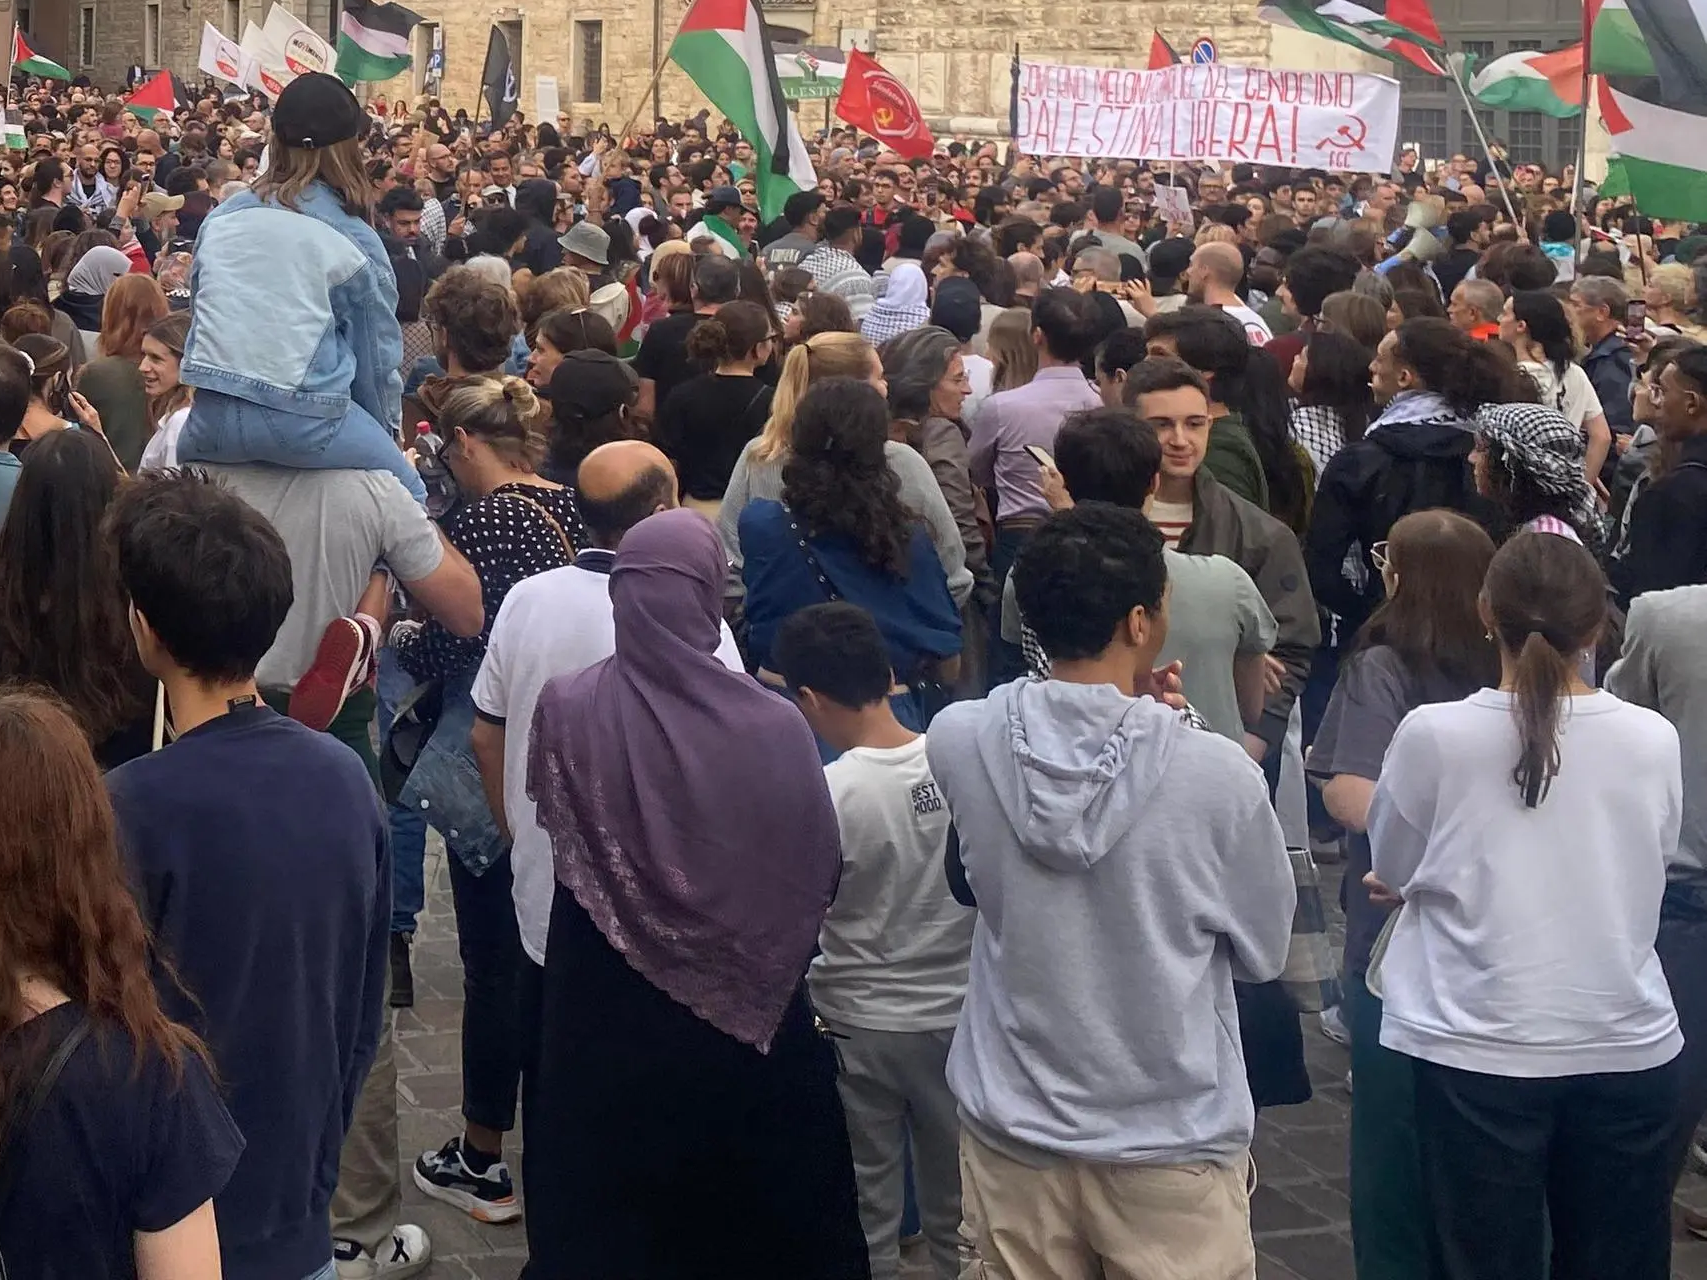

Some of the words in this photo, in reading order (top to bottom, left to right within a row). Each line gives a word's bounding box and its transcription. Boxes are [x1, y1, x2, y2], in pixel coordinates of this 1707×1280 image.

[1202, 65, 1231, 99] DEL
[1244, 68, 1354, 108] GENOCIDIO
[1017, 98, 1163, 157] PALESTINA
[1170, 100, 1299, 164] LIBERA!
[911, 782, 937, 803] BEST
[914, 797, 942, 817] MOOD
